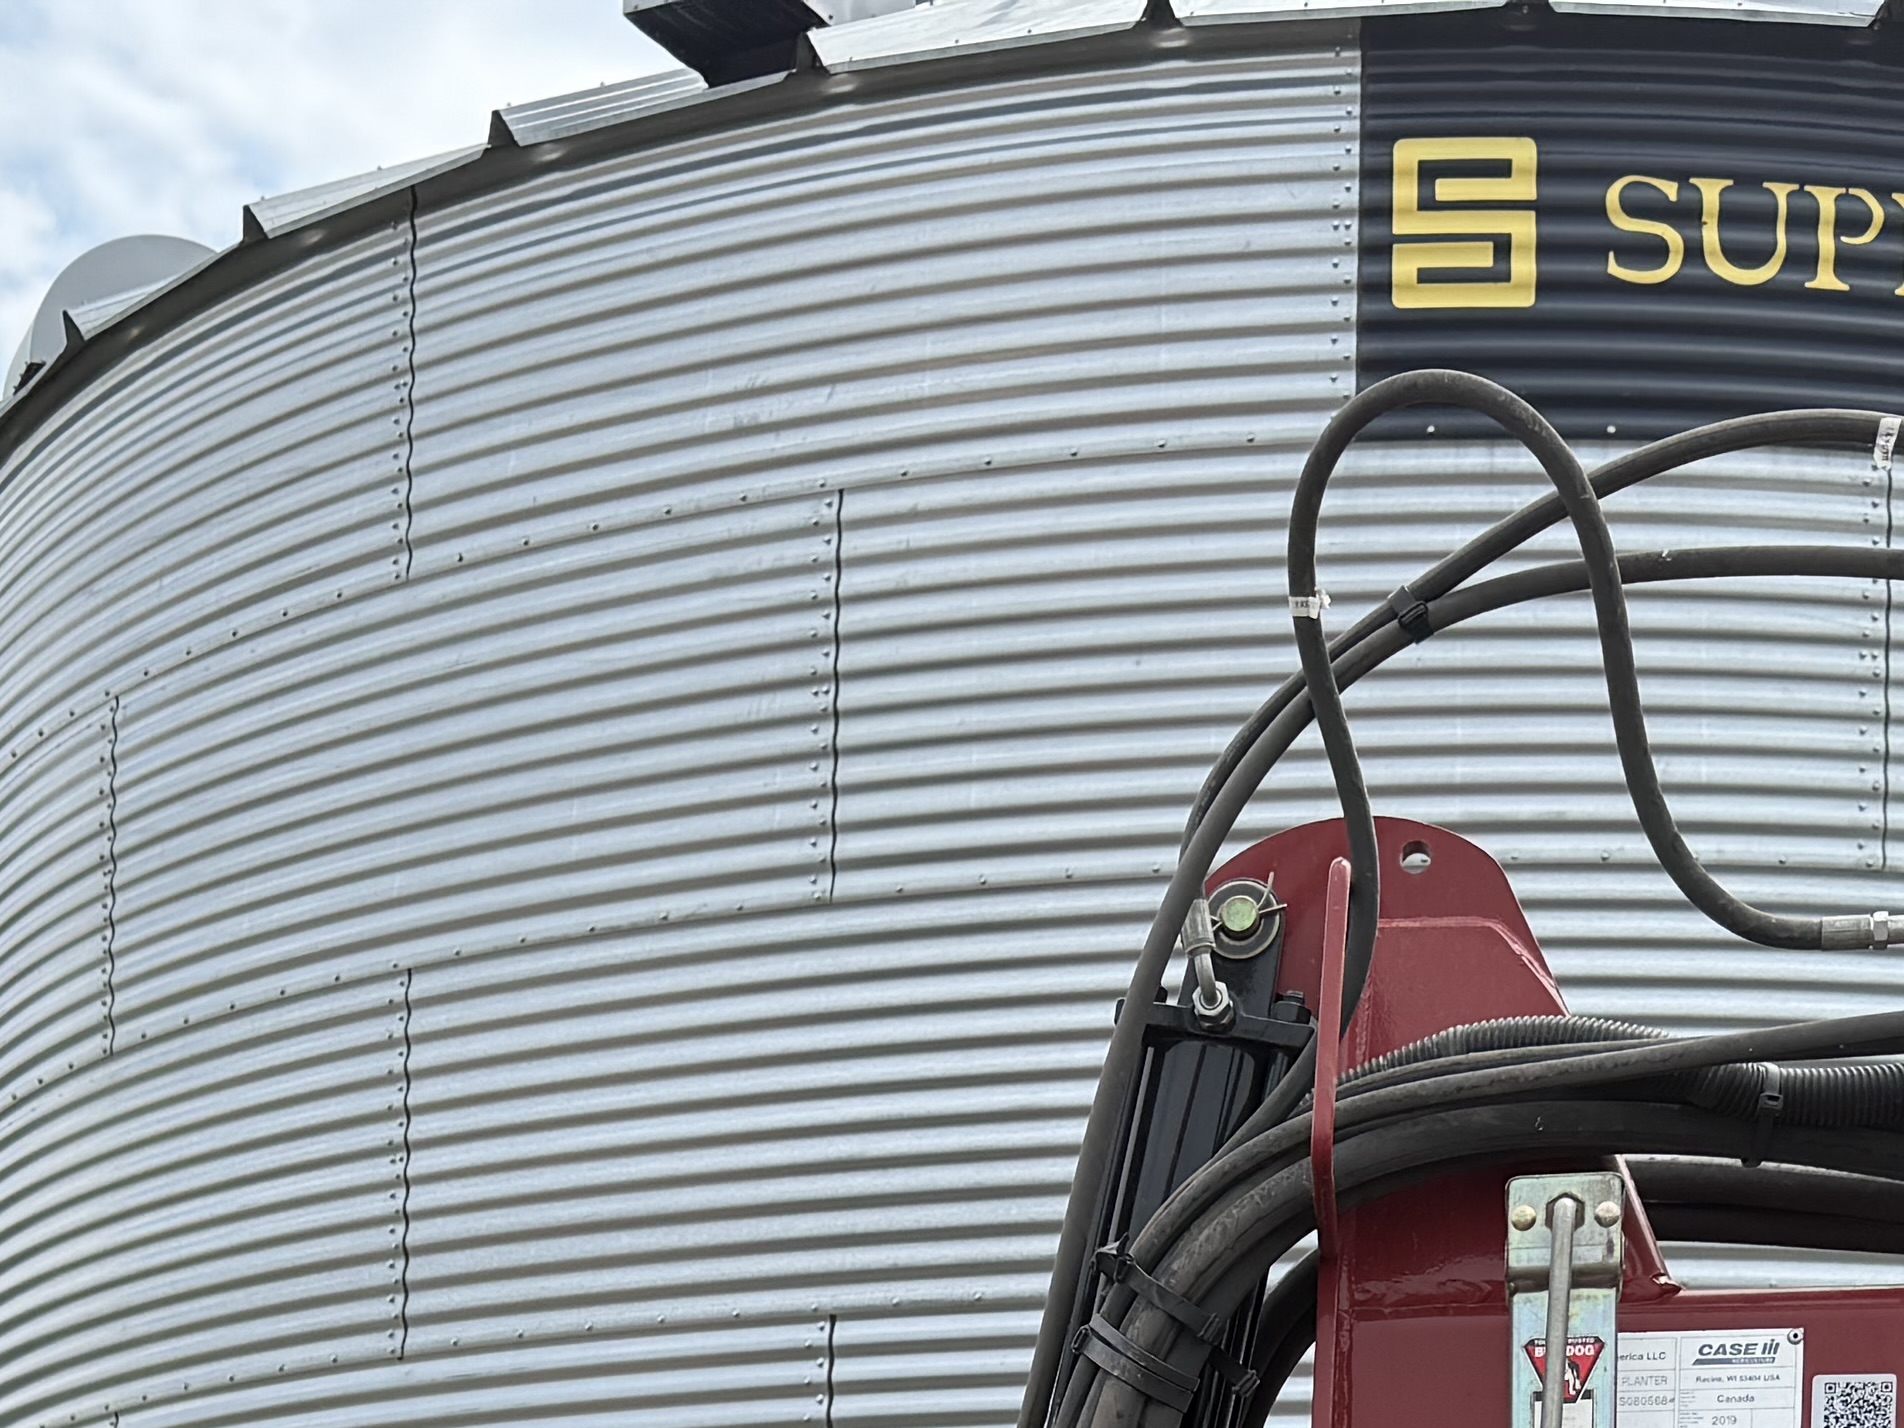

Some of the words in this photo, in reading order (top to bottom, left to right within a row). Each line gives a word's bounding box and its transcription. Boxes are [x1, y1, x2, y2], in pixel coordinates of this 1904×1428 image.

[1534, 1344, 1595, 1358] BDOG
[1698, 1342, 1759, 1356] CASE
[1646, 1351, 1666, 1361] LLC
[1621, 1375, 1668, 1387] PLANTER
[1763, 1373, 1780, 1382] USA
[1716, 1393, 1755, 1403] Canada
[1711, 1415, 1737, 1426] 2019
